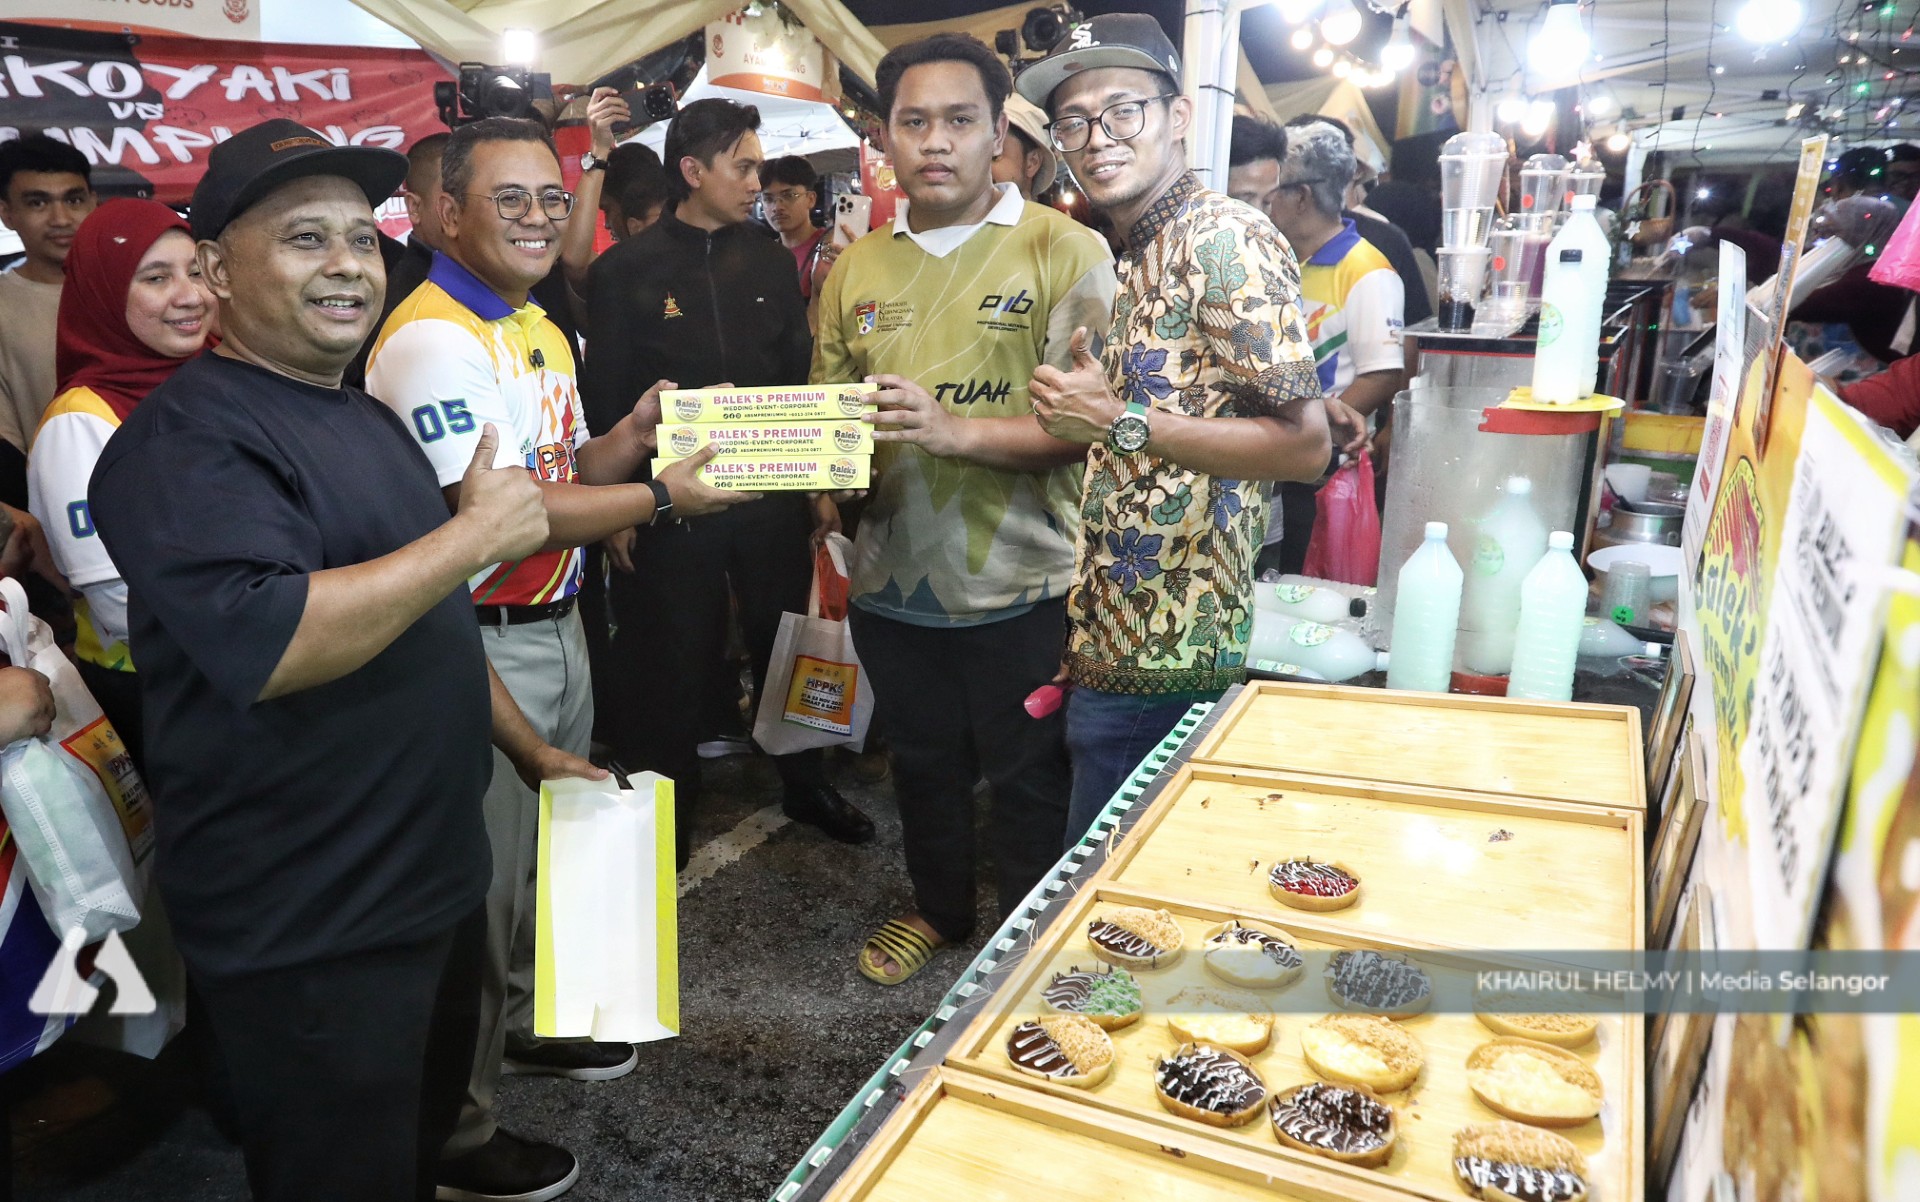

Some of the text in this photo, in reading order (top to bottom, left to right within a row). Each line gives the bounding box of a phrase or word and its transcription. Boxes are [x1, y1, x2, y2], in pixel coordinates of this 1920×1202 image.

[714, 392, 826, 405] BALEK'S PREMIUM
[411, 398, 476, 444] 05
[710, 428, 822, 439] BALEK'S PREMIUM
[705, 462, 817, 474] BALEK'S PREMIUM
